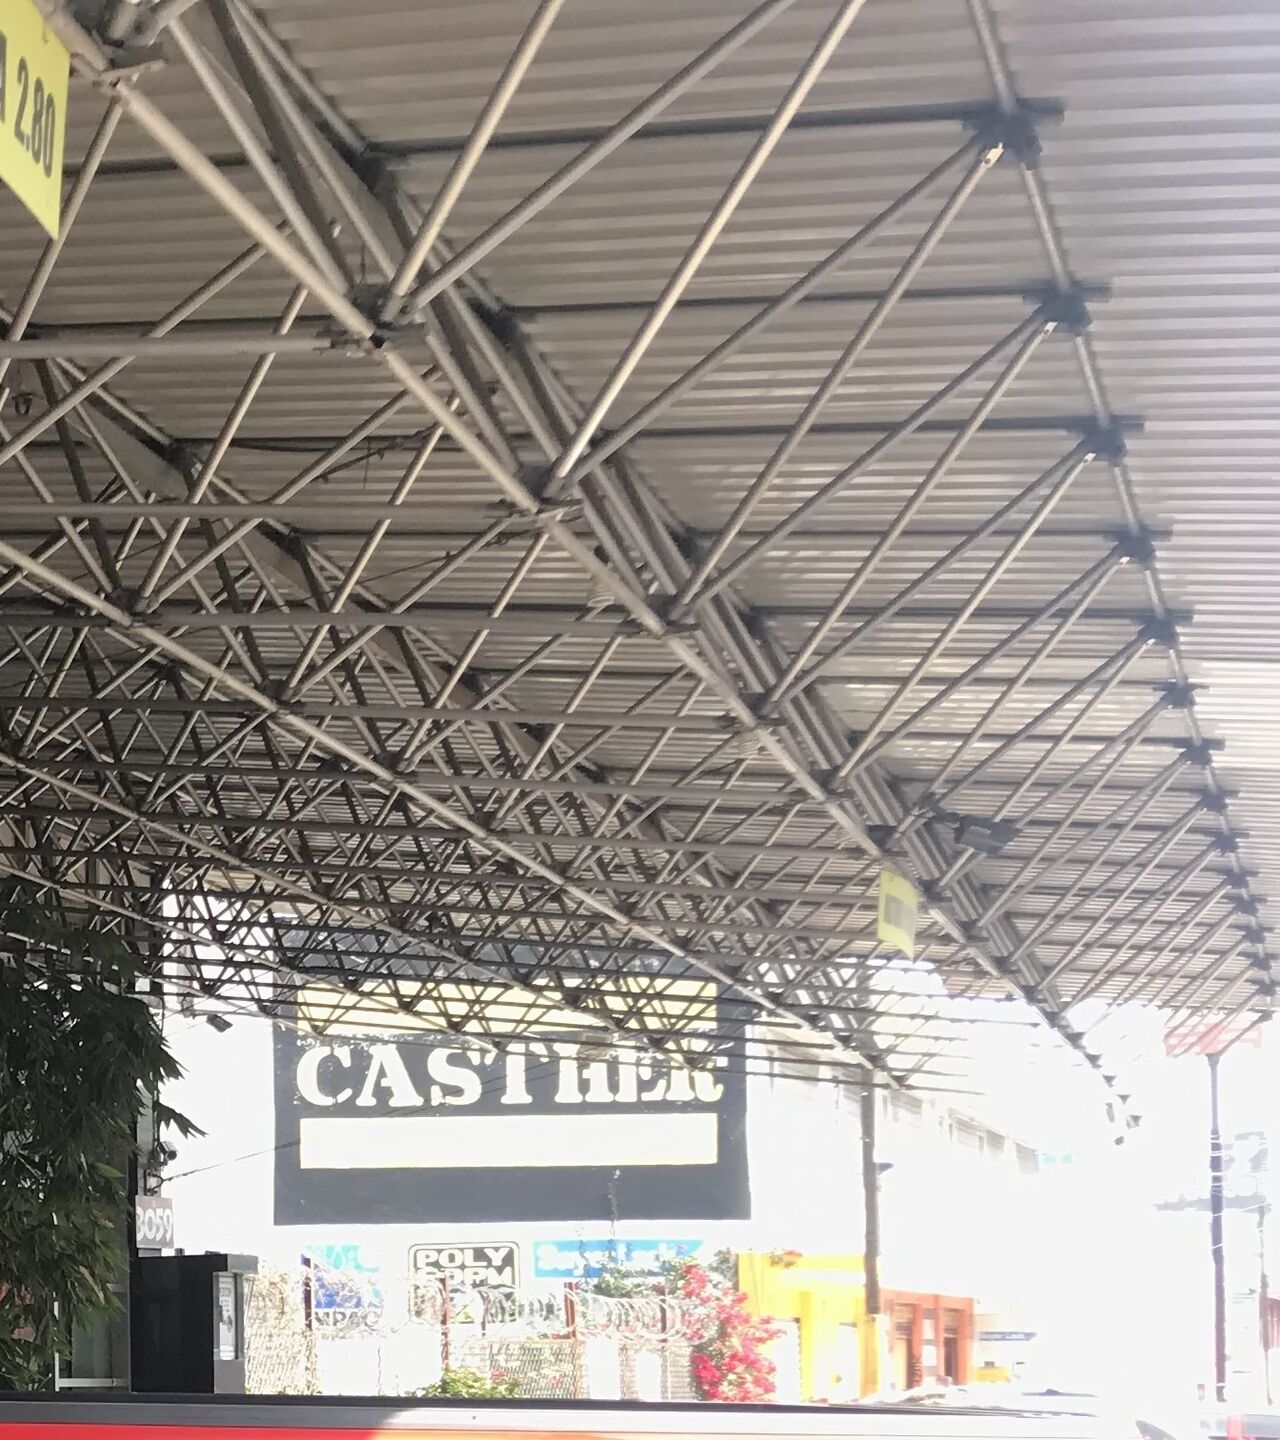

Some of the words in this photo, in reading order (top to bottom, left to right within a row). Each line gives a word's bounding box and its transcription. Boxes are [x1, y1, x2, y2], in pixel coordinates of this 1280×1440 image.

[13, 55, 56, 178] 2.80
[296, 1041, 728, 1107] CASTHER
[416, 1248, 510, 1268] POLY
